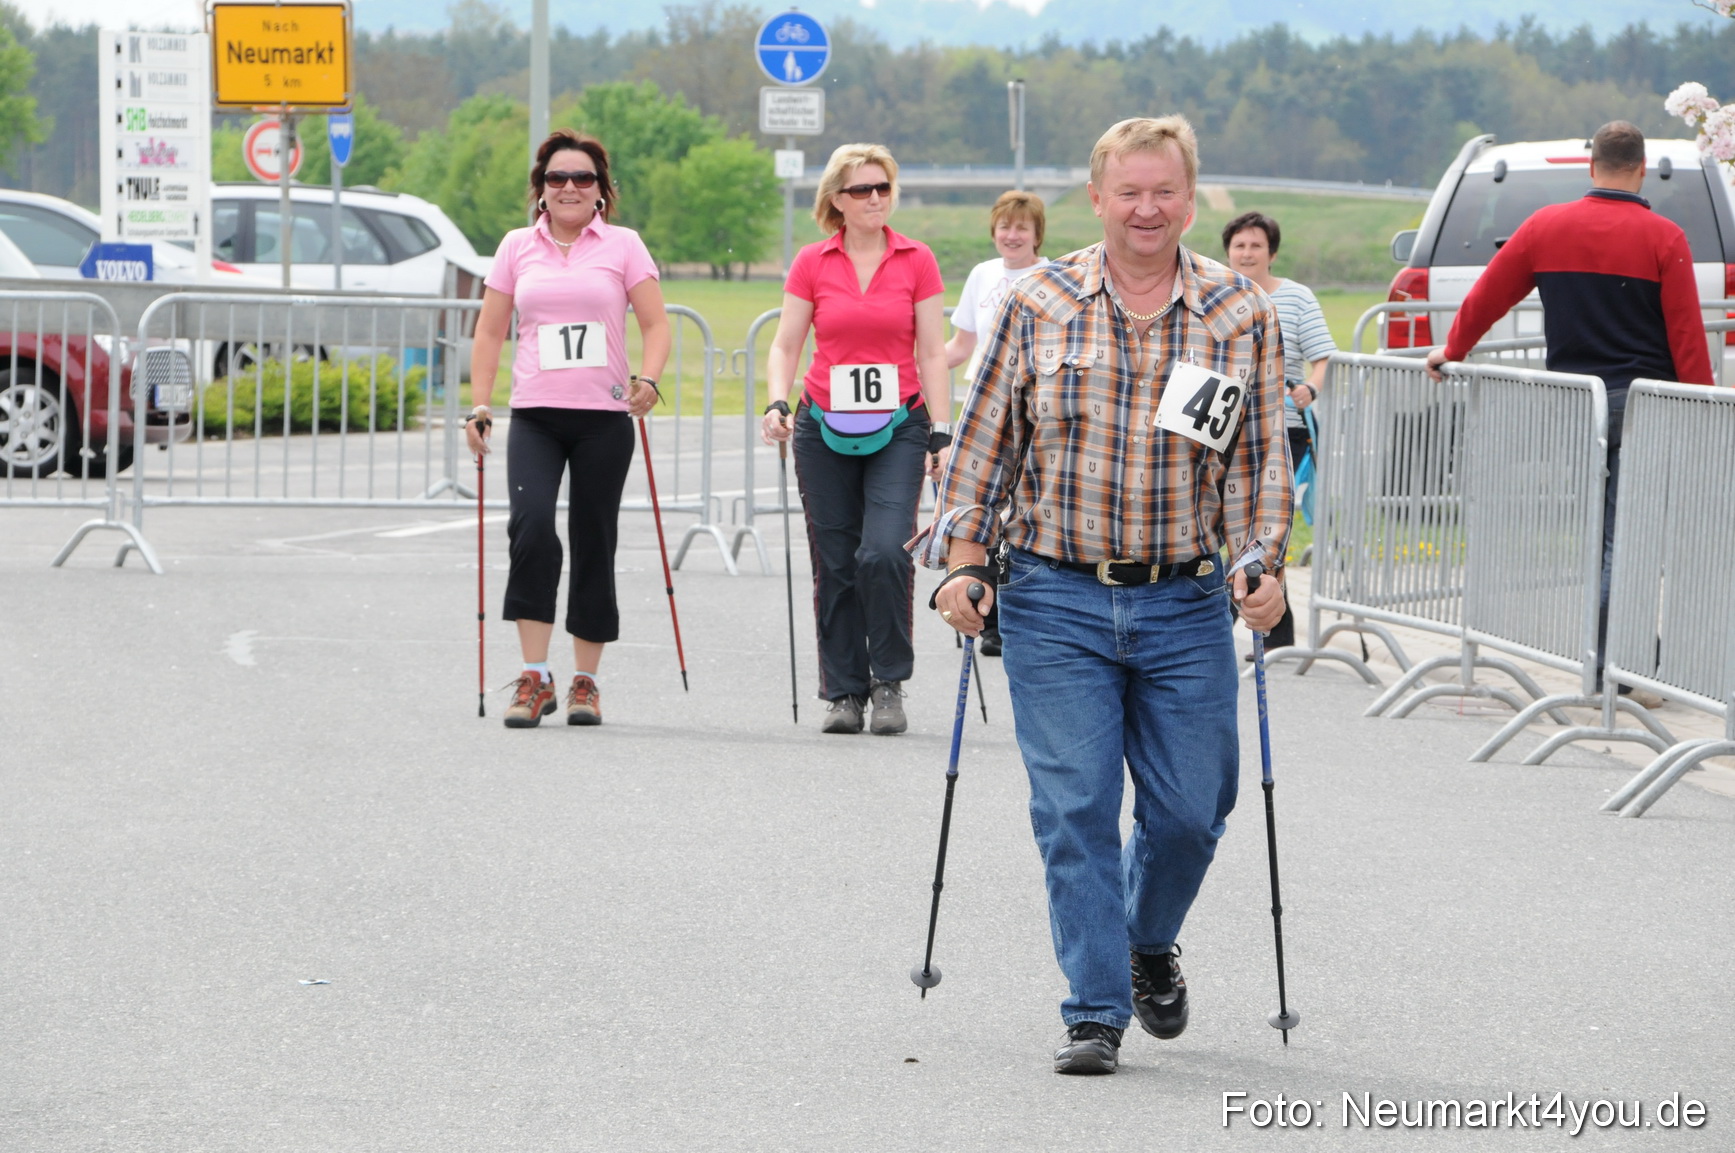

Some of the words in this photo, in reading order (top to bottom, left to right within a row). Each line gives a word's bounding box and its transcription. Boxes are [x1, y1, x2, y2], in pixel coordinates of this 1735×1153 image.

[262, 20, 299, 32] Nach
[227, 40, 334, 64] Neumarkt
[264, 73, 272, 87] 5
[283, 76, 302, 88] km
[126, 107, 146, 131] SHB
[126, 177, 160, 200] THULE
[95, 260, 148, 281] VOLVO
[559, 324, 587, 361] 17
[849, 367, 882, 404] 16
[1181, 376, 1241, 440] 43
